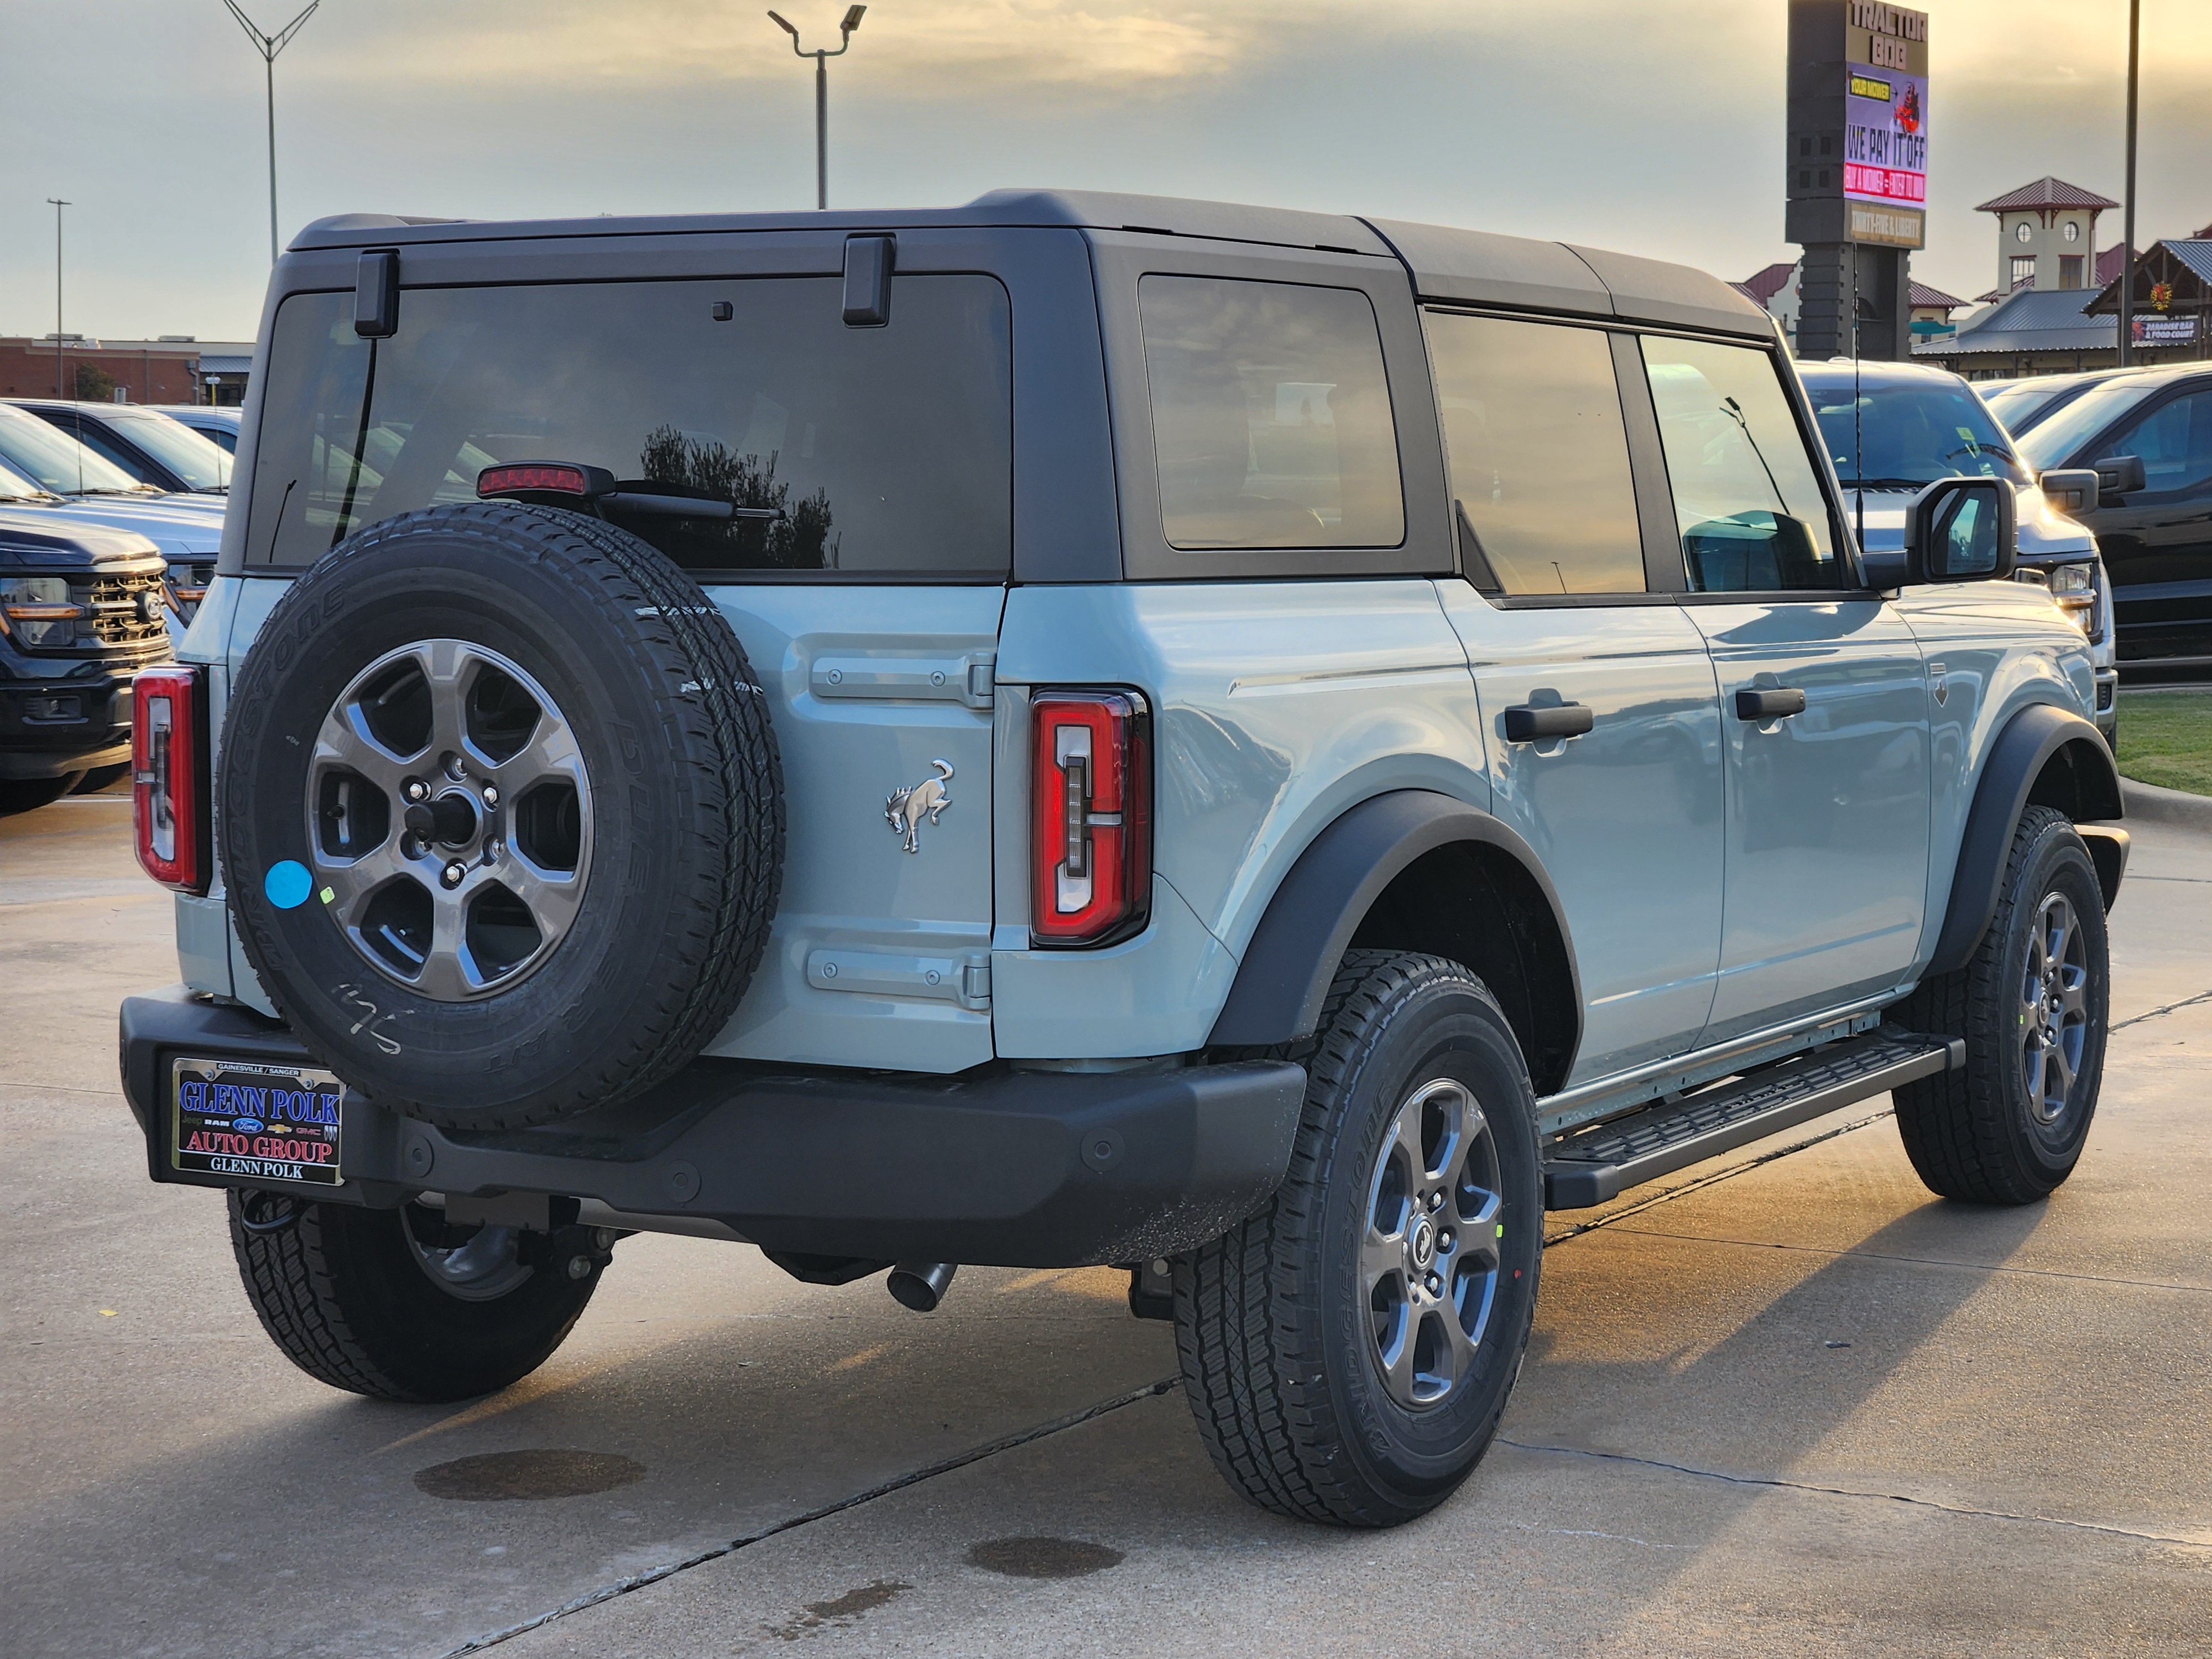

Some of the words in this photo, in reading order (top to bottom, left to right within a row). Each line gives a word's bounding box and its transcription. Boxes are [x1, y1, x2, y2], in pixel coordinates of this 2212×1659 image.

[1852, 0, 1928, 41] TRACTOR
[1872, 35, 1907, 70] BOB
[1851, 78, 1867, 95] YOUR
[1867, 81, 1890, 100] MOWER
[1849, 124, 1866, 160] WE
[1870, 128, 1890, 164] PAY
[1893, 131, 1903, 166] IT
[1907, 134, 1924, 170] OFF
[2146, 322, 2179, 331] PARADISE
[2179, 321, 2194, 330] BAR
[218, 1063, 264, 1074] GAINESVILLE
[269, 1067, 299, 1077] SANGER
[180, 1081, 268, 1118] GLENN
[271, 1089, 340, 1125] POLK
[182, 1115, 202, 1126] Jeep
[238, 1119, 258, 1132] Ford
[296, 1128, 321, 1136] GMC
[186, 1131, 248, 1155] AUTO
[253, 1136, 332, 1163] GROUP
[211, 1157, 260, 1175] GLENN
[264, 1162, 303, 1179] POLK
